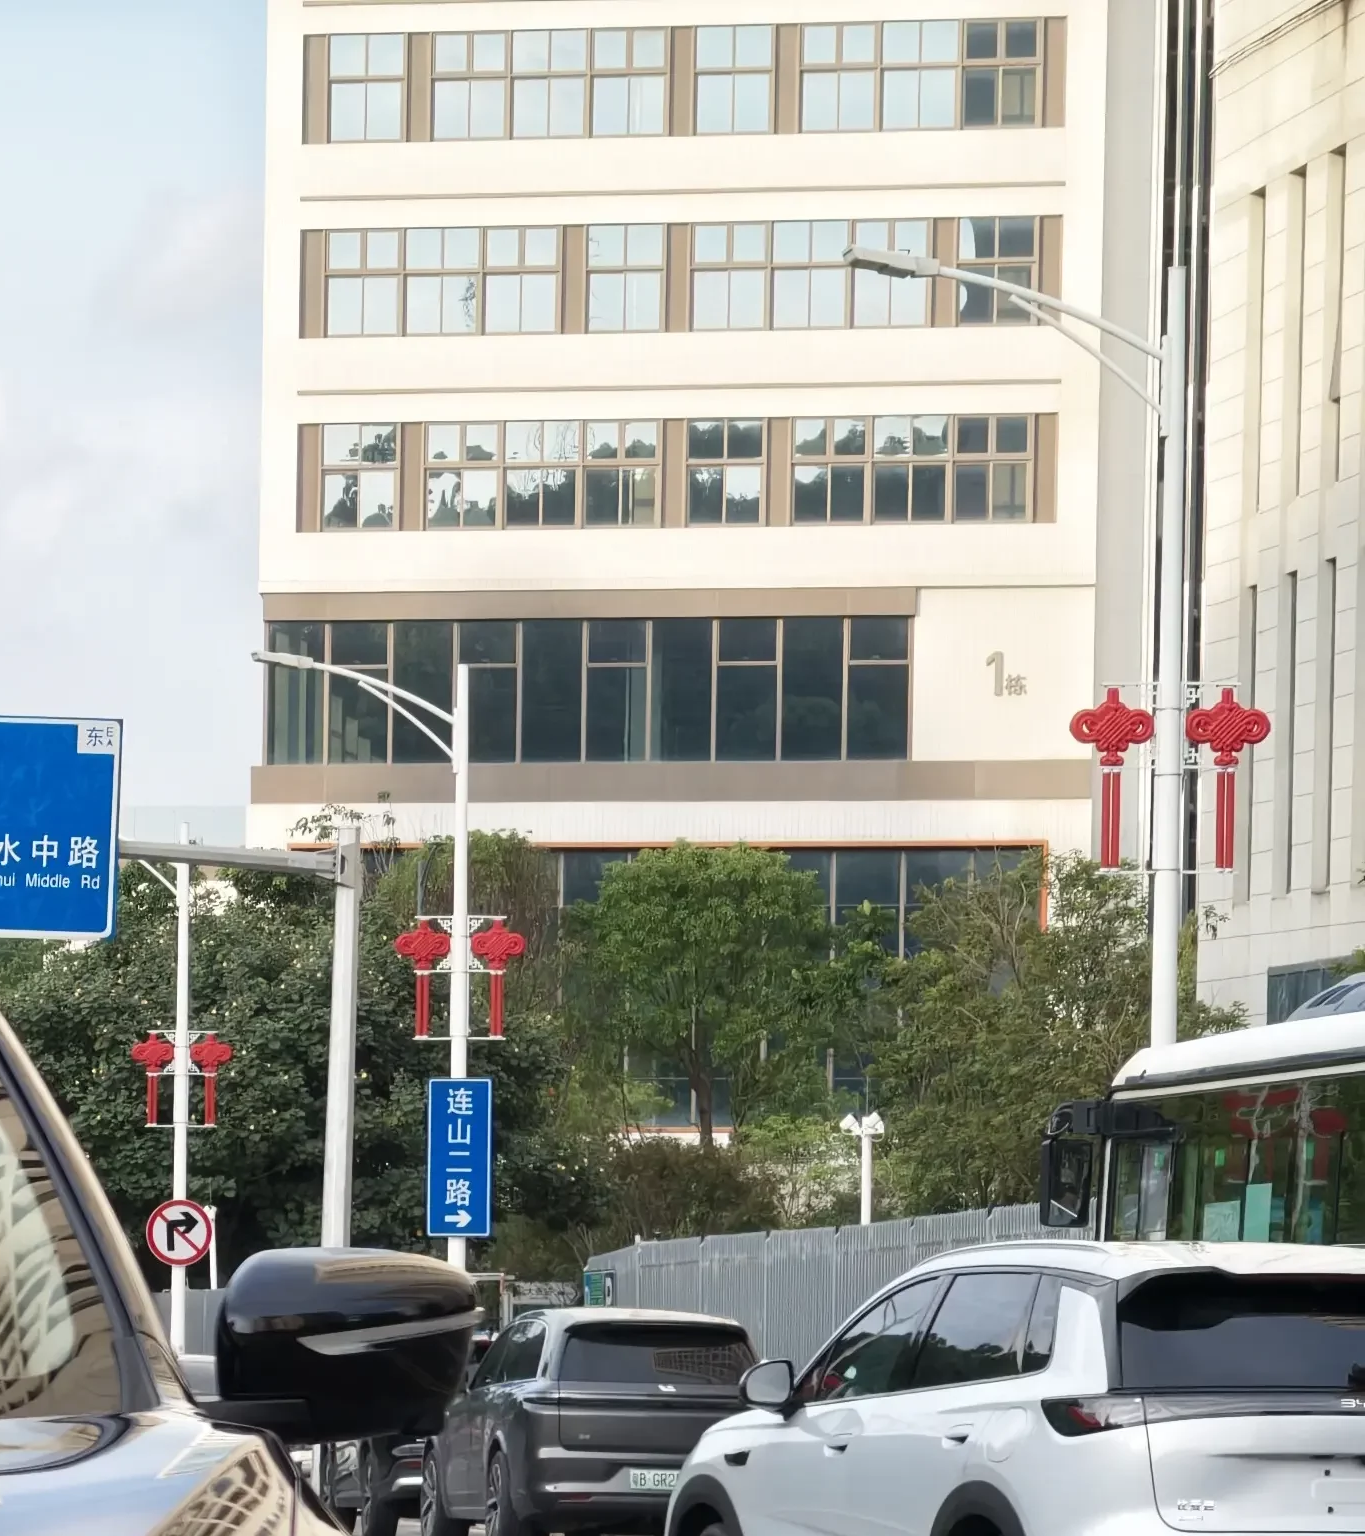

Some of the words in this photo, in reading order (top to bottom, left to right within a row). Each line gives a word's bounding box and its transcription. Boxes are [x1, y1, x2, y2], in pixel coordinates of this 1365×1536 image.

[85, 726, 104, 748] 东
[105, 726, 114, 738] E
[25, 872, 71, 889] Middle
[81, 874, 101, 890] Rd
[444, 1087, 474, 1207] 连山二路
